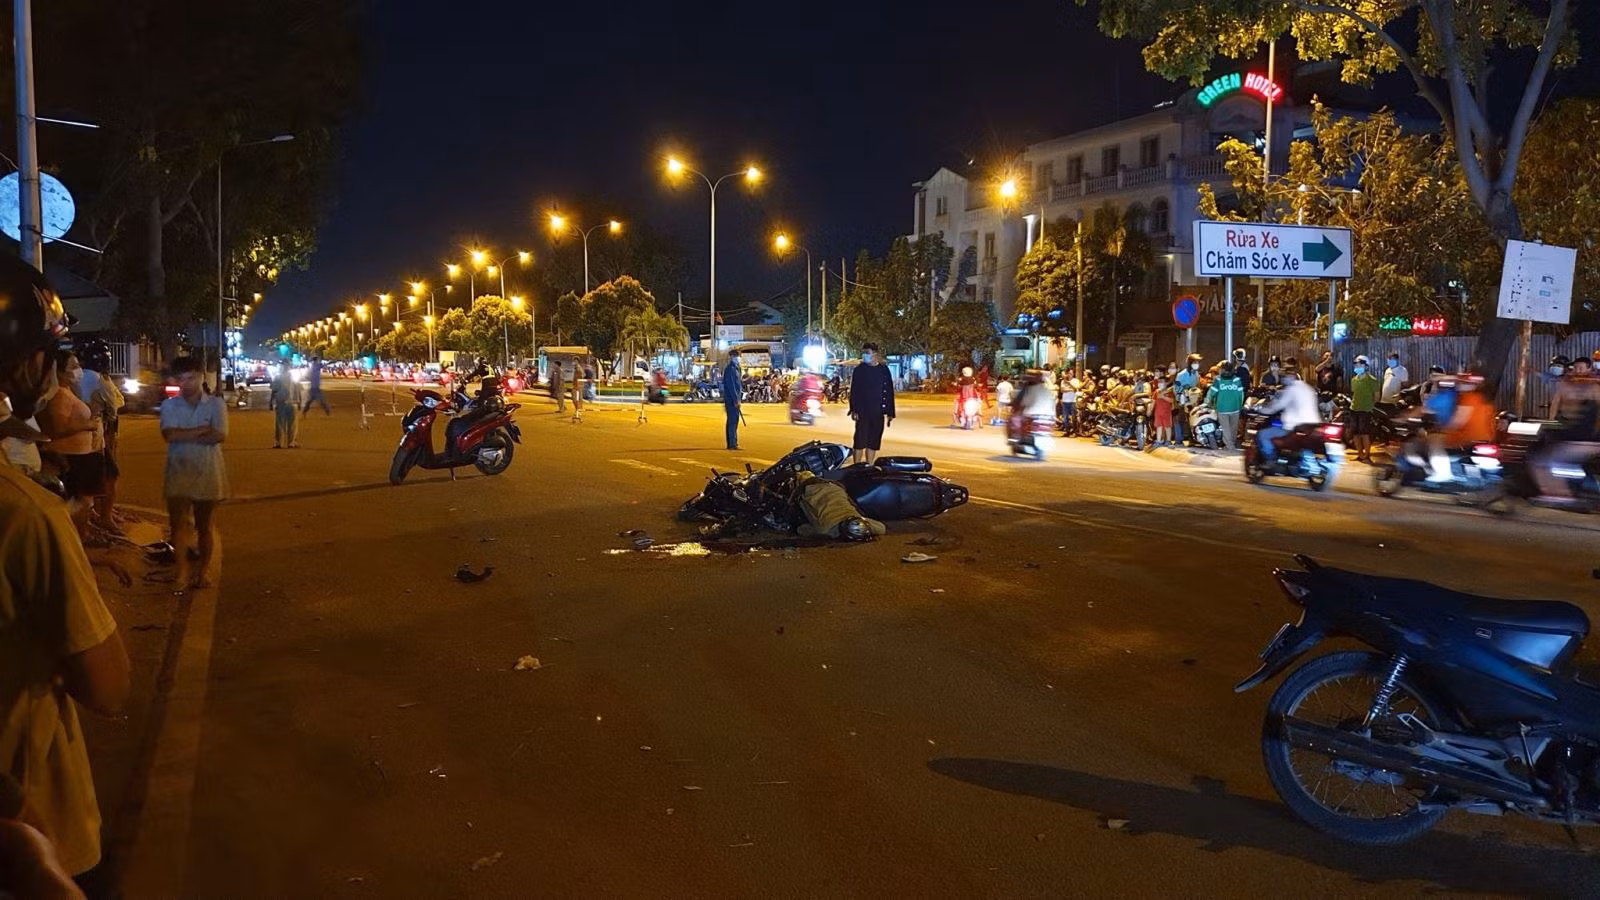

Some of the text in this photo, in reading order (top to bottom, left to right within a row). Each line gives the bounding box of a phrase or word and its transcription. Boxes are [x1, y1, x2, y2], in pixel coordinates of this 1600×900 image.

[1197, 72, 1241, 105] GREEN
[1226, 229, 1279, 249] Rửa Xe
[1206, 250, 1299, 271] Chăm Sóc Xe
[1219, 383, 1238, 391] Grab
